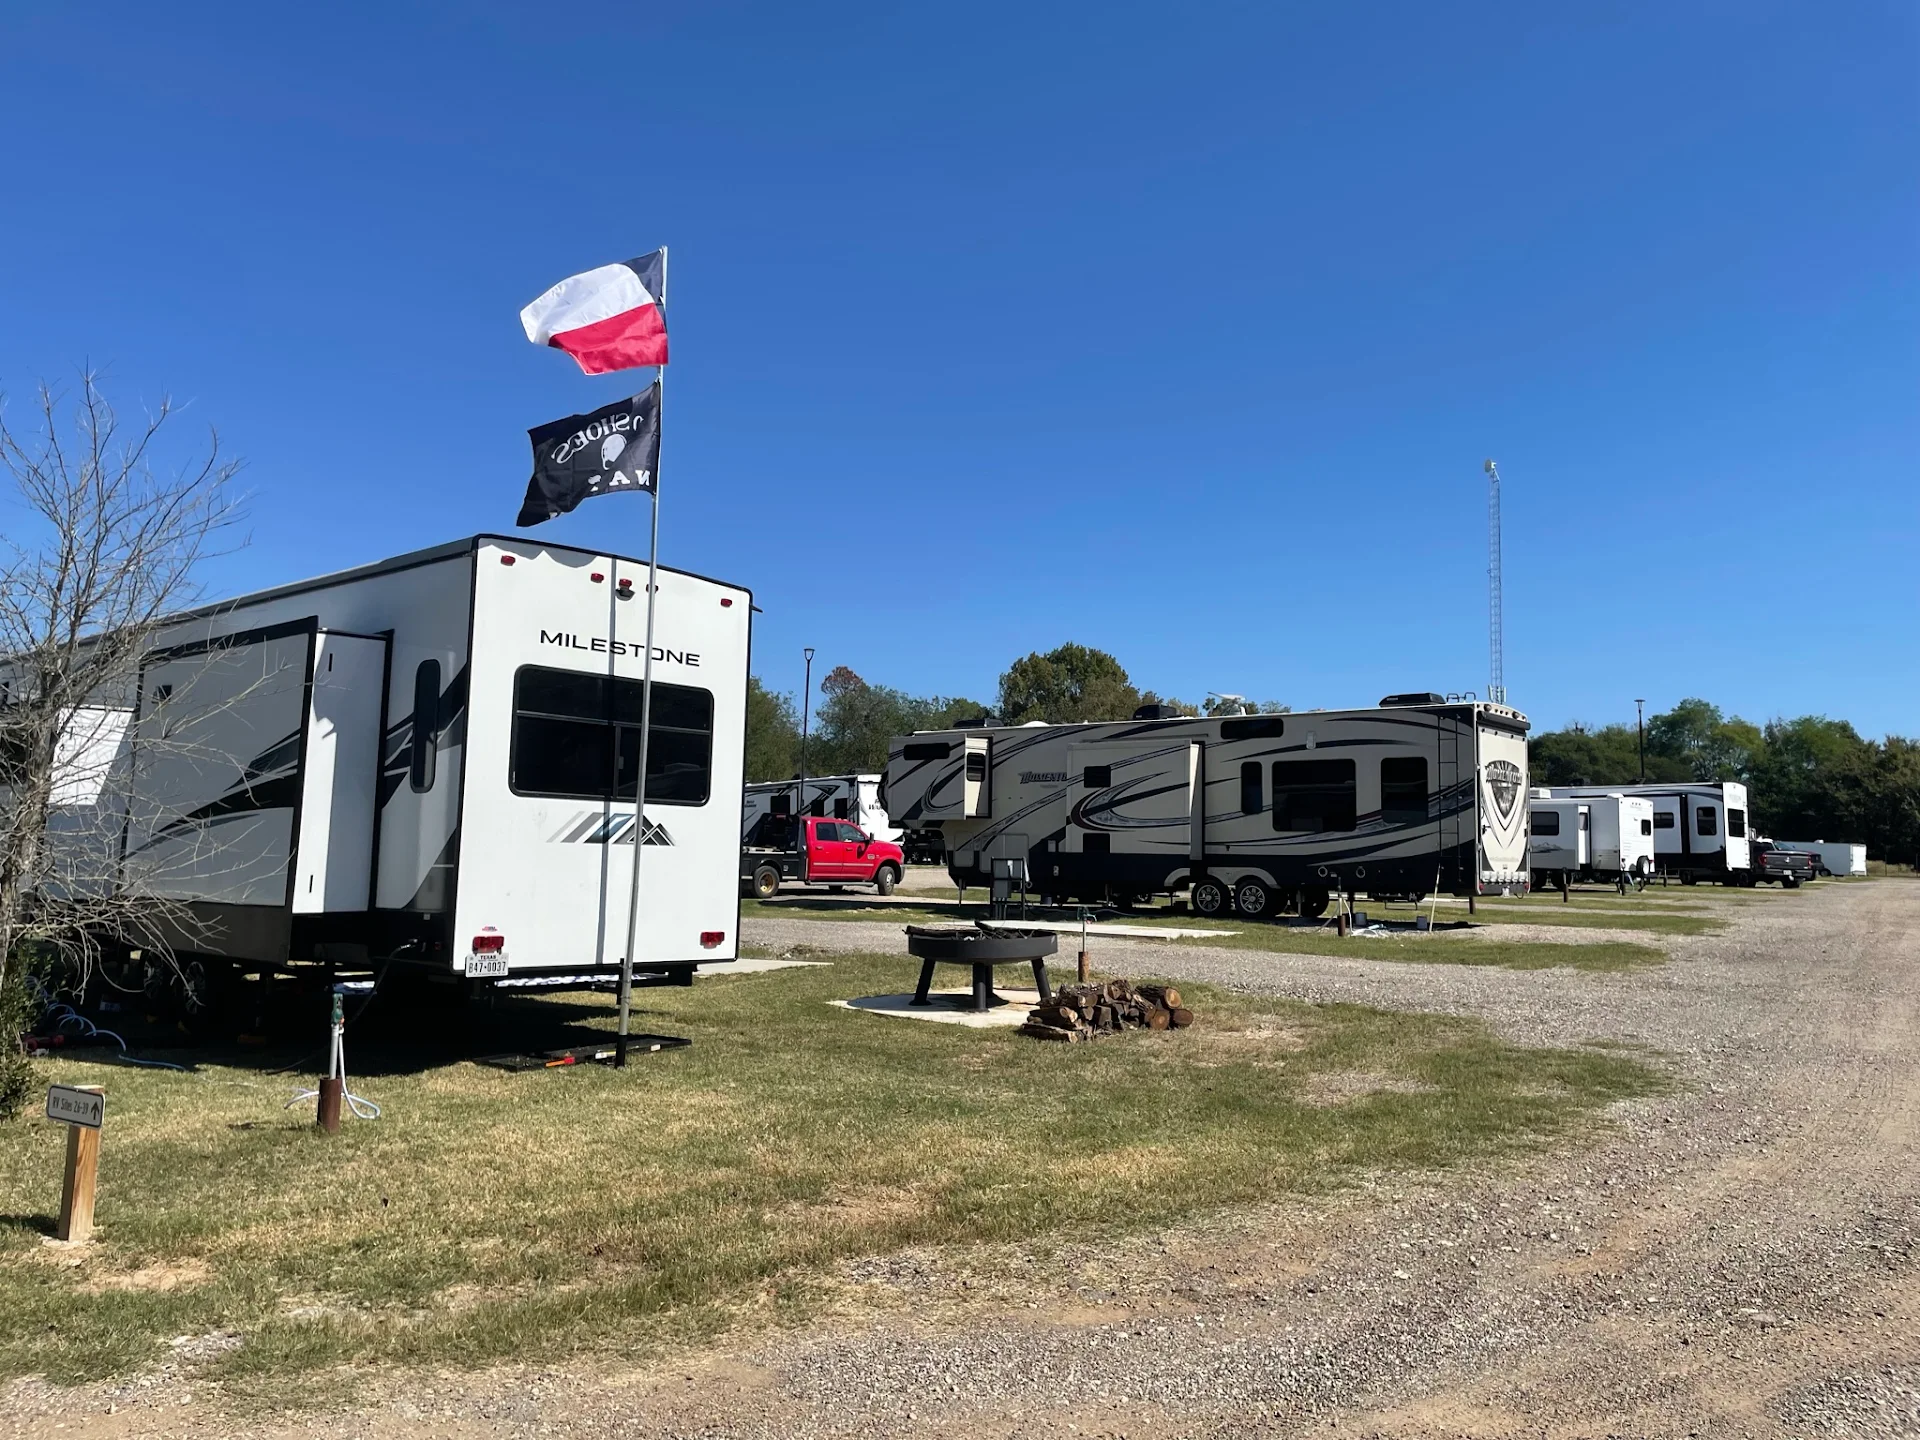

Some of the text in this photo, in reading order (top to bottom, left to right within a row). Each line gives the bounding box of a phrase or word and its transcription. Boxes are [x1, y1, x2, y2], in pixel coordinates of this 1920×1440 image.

[540, 629, 700, 667] MILESTONE
[52, 1096, 60, 1109] RV
[61, 1098, 73, 1112] Sites
